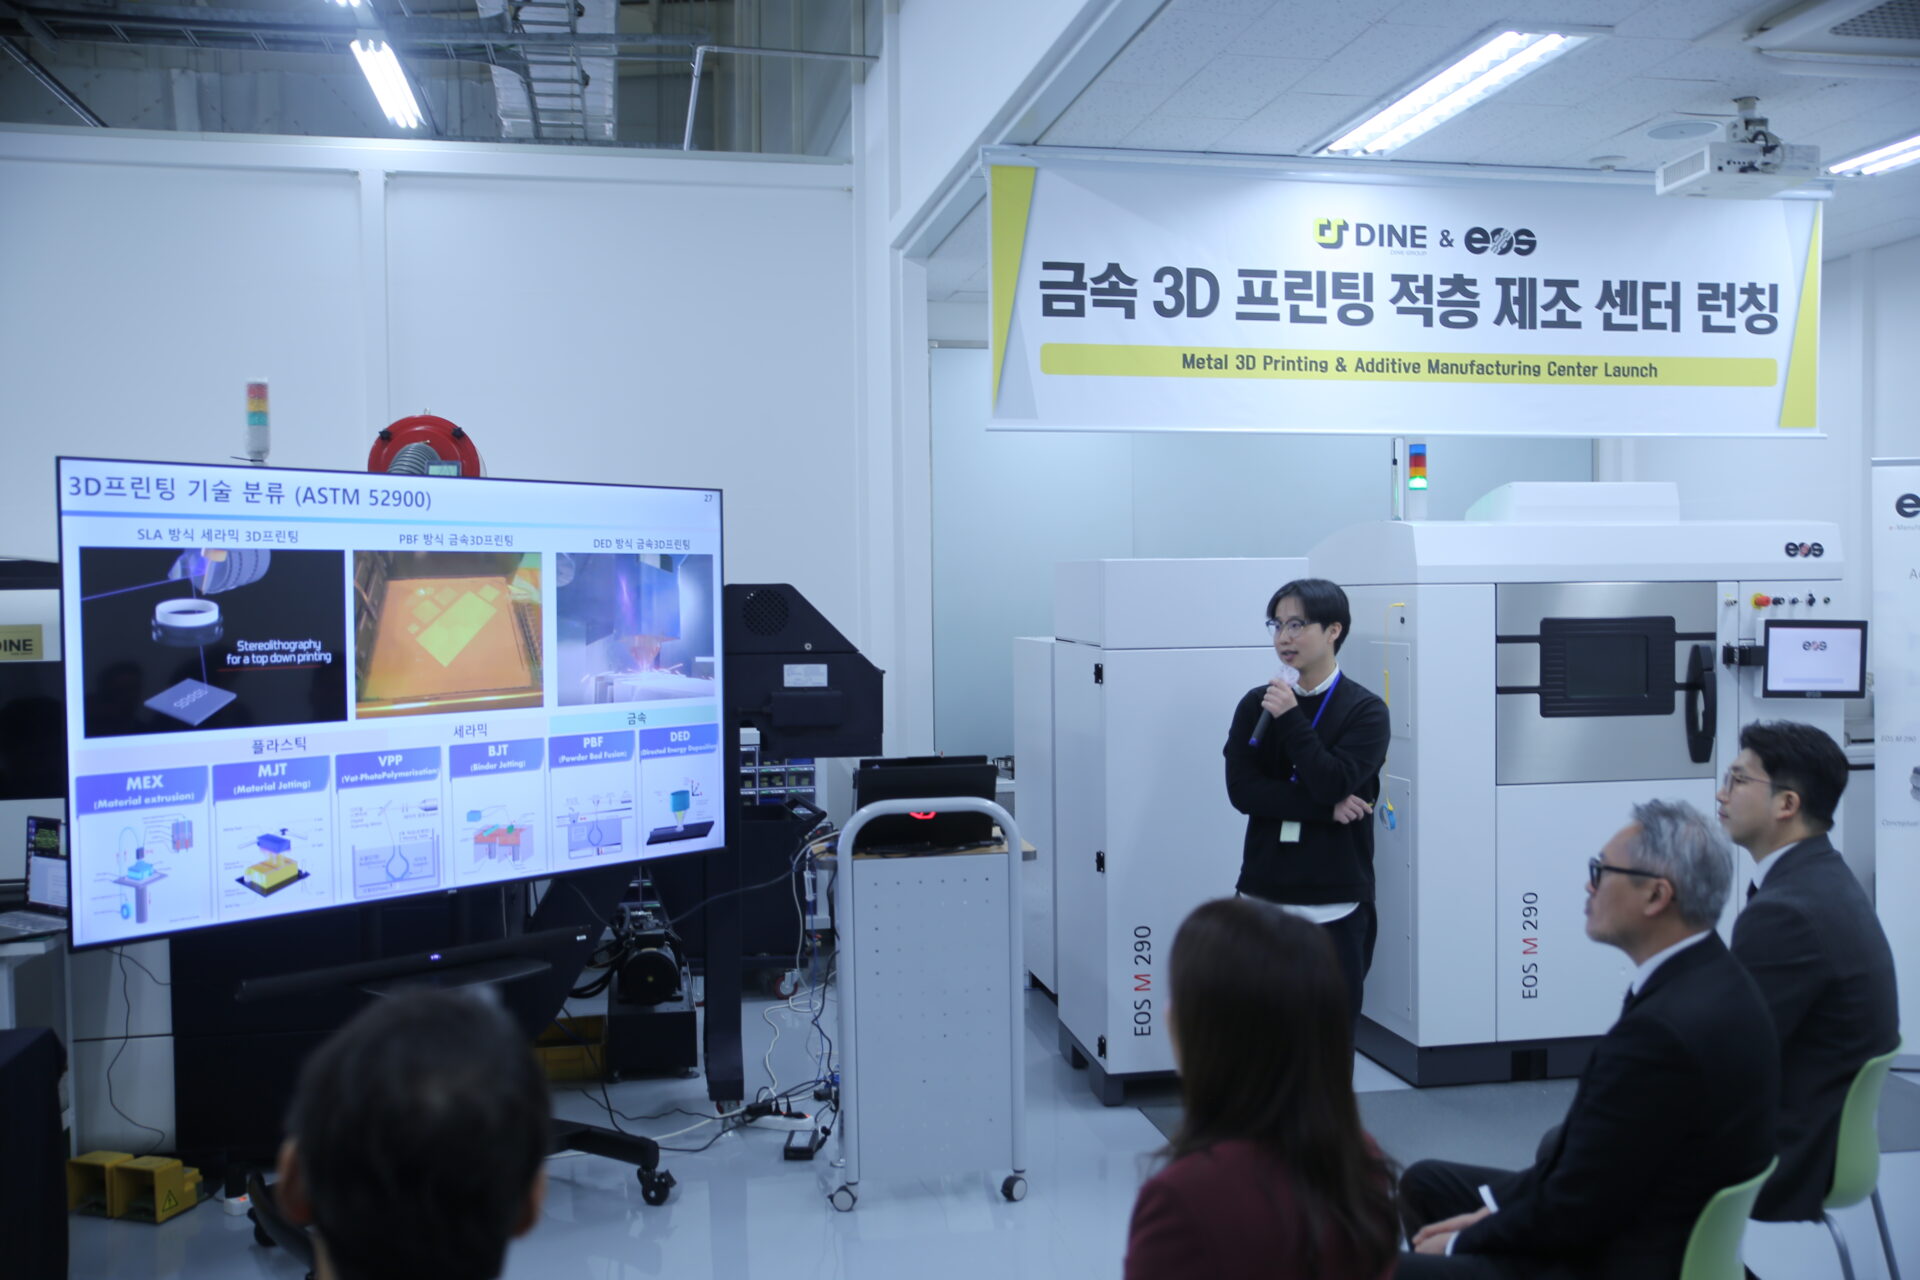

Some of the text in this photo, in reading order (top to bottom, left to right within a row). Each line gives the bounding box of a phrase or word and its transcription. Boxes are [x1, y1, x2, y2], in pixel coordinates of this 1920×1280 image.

[1355, 222, 1538, 257] DINE & eos
[1039, 261, 1780, 336] 금속 3D 프린팅 적층 제조 센터 런칭
[1182, 353, 1658, 378] Metal 3D Printing & Additive Manufacturing Center Launch
[68, 476, 432, 511] 3D프린팅 기술 분류 (ASTM 52900)
[704, 493, 713, 503] 27
[137, 527, 300, 544] SLA 방식 세라믹 3D프린팅
[399, 533, 513, 547] PBF 방식 금속3D프린팅
[593, 539, 613, 549] DED
[615, 539, 633, 550] 방식
[1784, 542, 1825, 558] eos
[0, 638, 33, 652] INE
[236, 639, 322, 653] Stereolithography
[226, 651, 333, 666] for a top down printing
[627, 712, 647, 726] 금속
[453, 723, 488, 739] 세라믹
[670, 730, 691, 743] DED
[252, 736, 307, 755] 플라스틱
[583, 736, 604, 749] PBF
[488, 745, 509, 757] BJT
[378, 755, 403, 767] VPP
[470, 762, 497, 772] (Binder
[258, 763, 287, 778] MJT
[126, 775, 164, 791] MEX
[233, 780, 311, 795] (Material Jetting)
[93, 792, 195, 810] (Material extrusion)
[1522, 892, 1538, 999] EOS M 290
[1134, 926, 1151, 1037] EOS M 290
